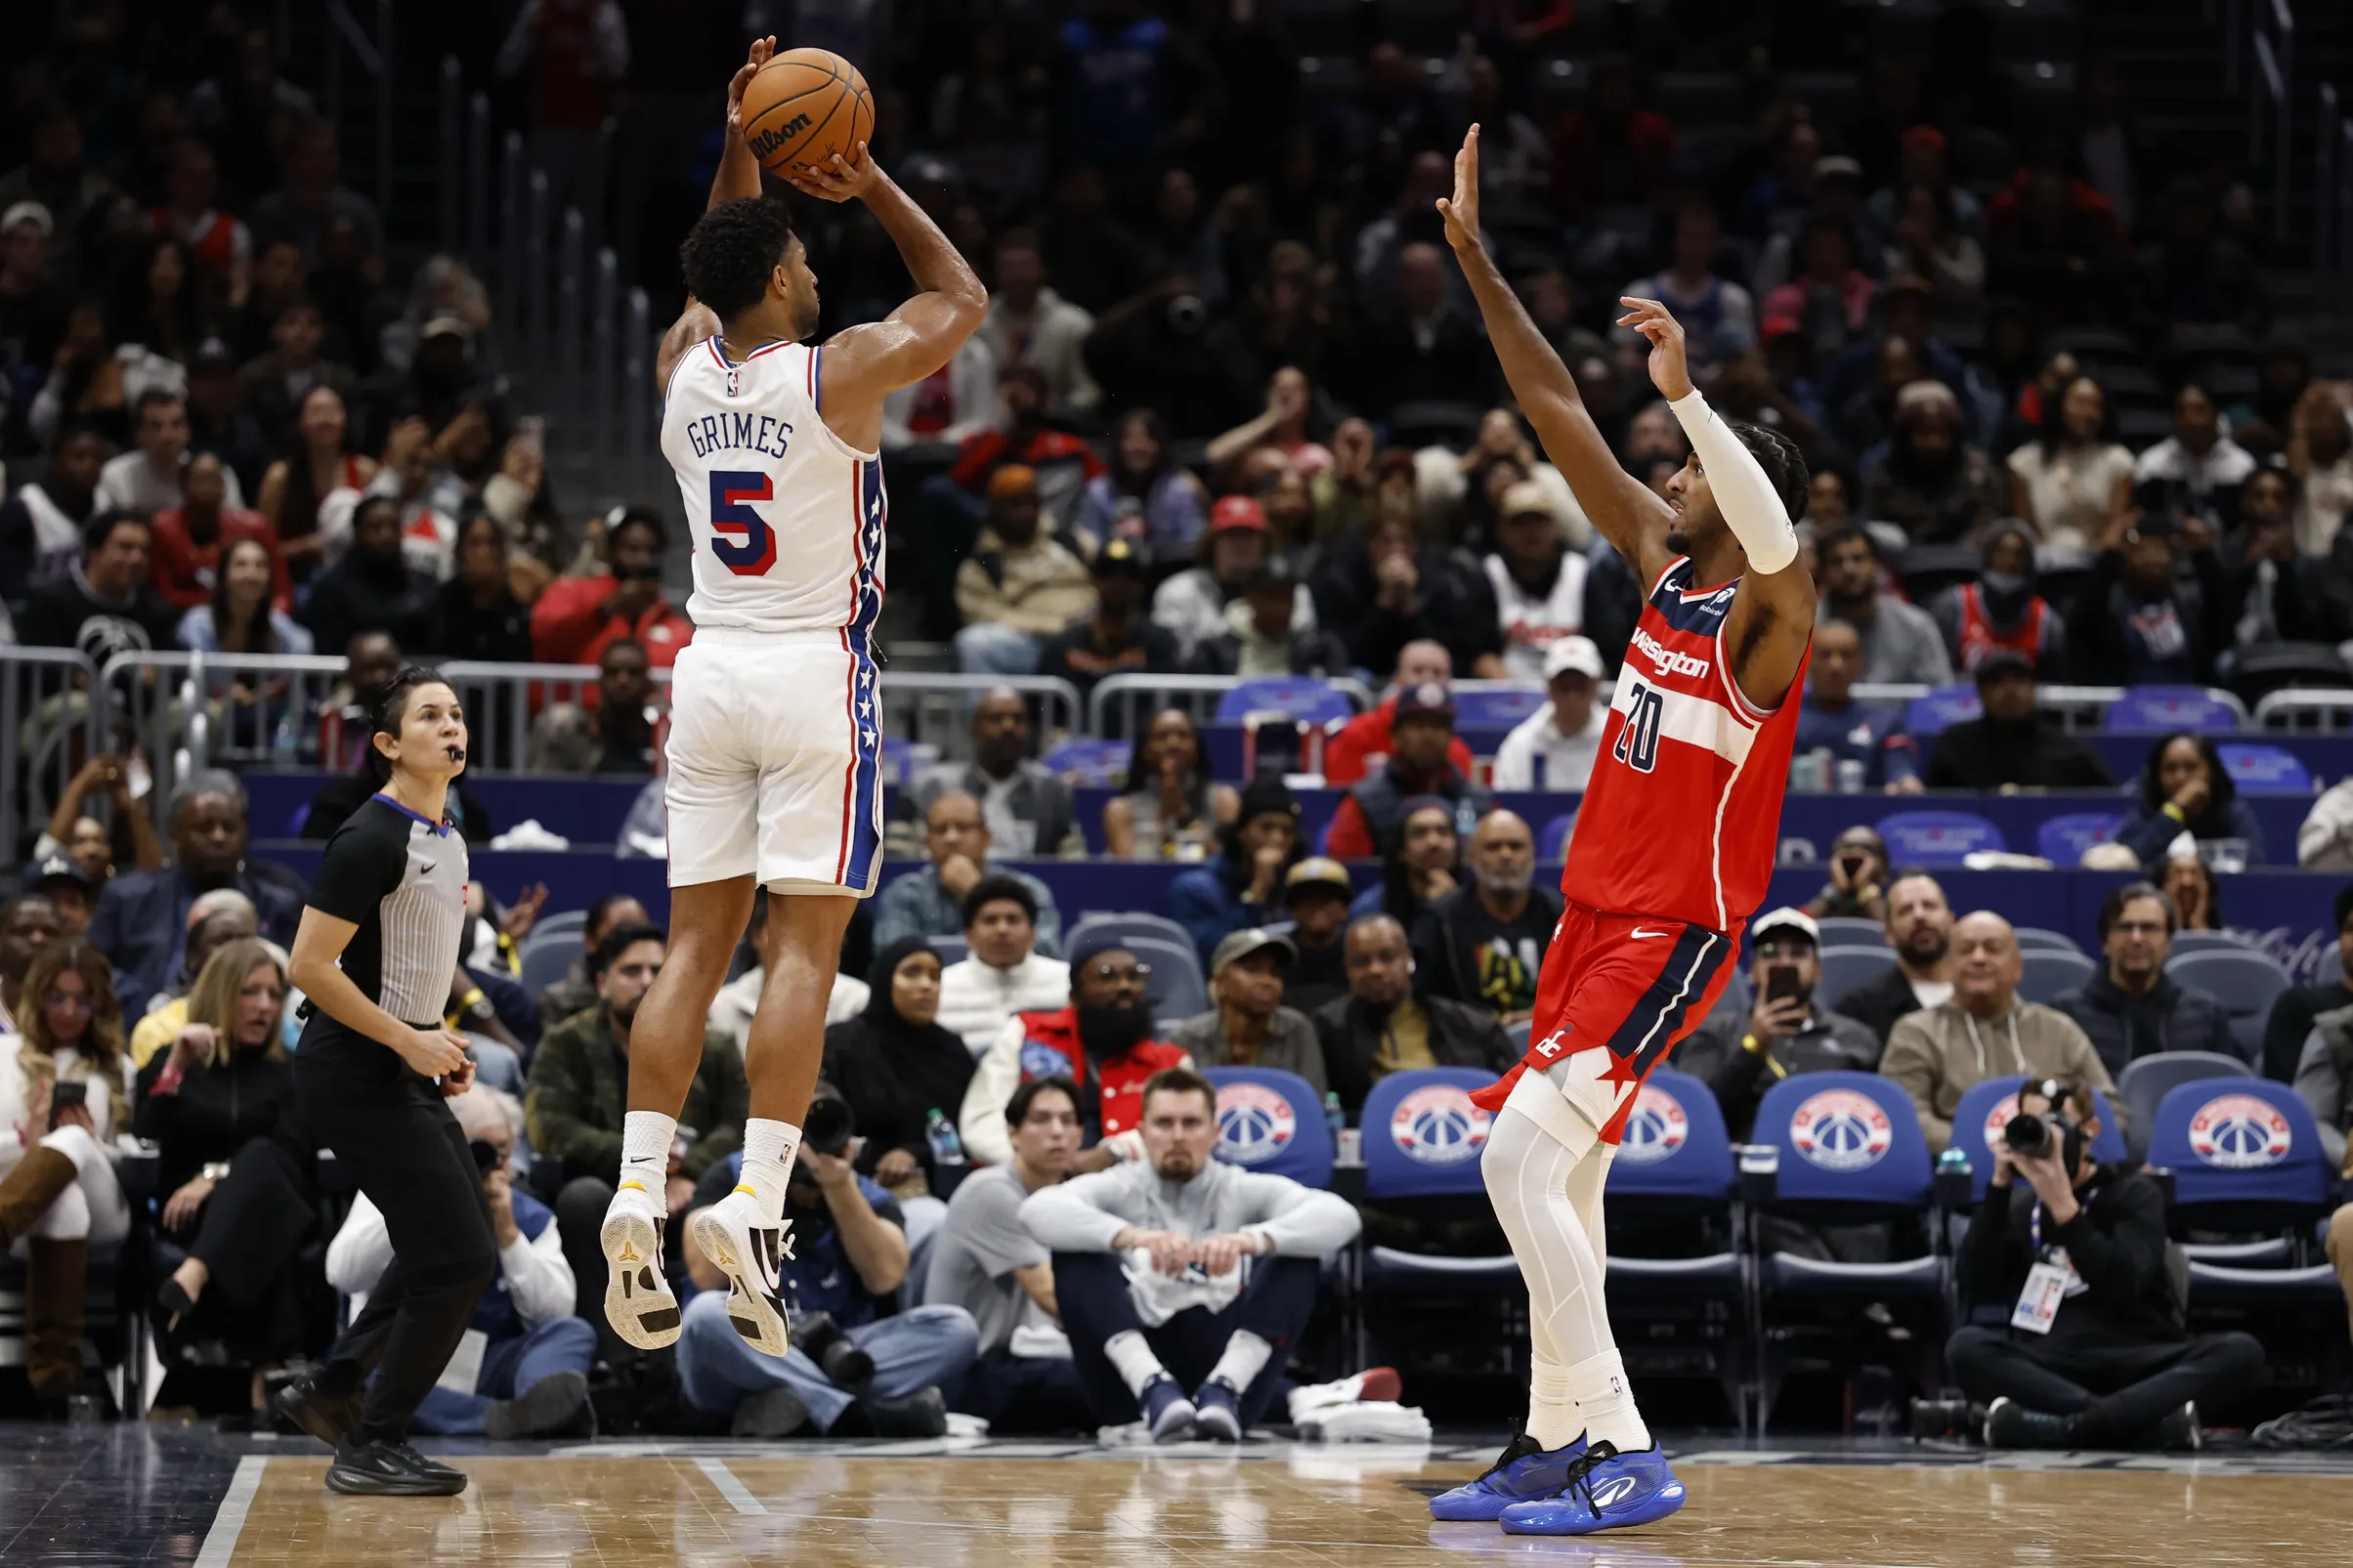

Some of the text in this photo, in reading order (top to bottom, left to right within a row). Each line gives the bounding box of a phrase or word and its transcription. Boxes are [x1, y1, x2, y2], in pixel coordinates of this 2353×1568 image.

[687, 411, 793, 459] GRIMES
[709, 470, 777, 576] 5
[1613, 683, 1663, 774] 20
